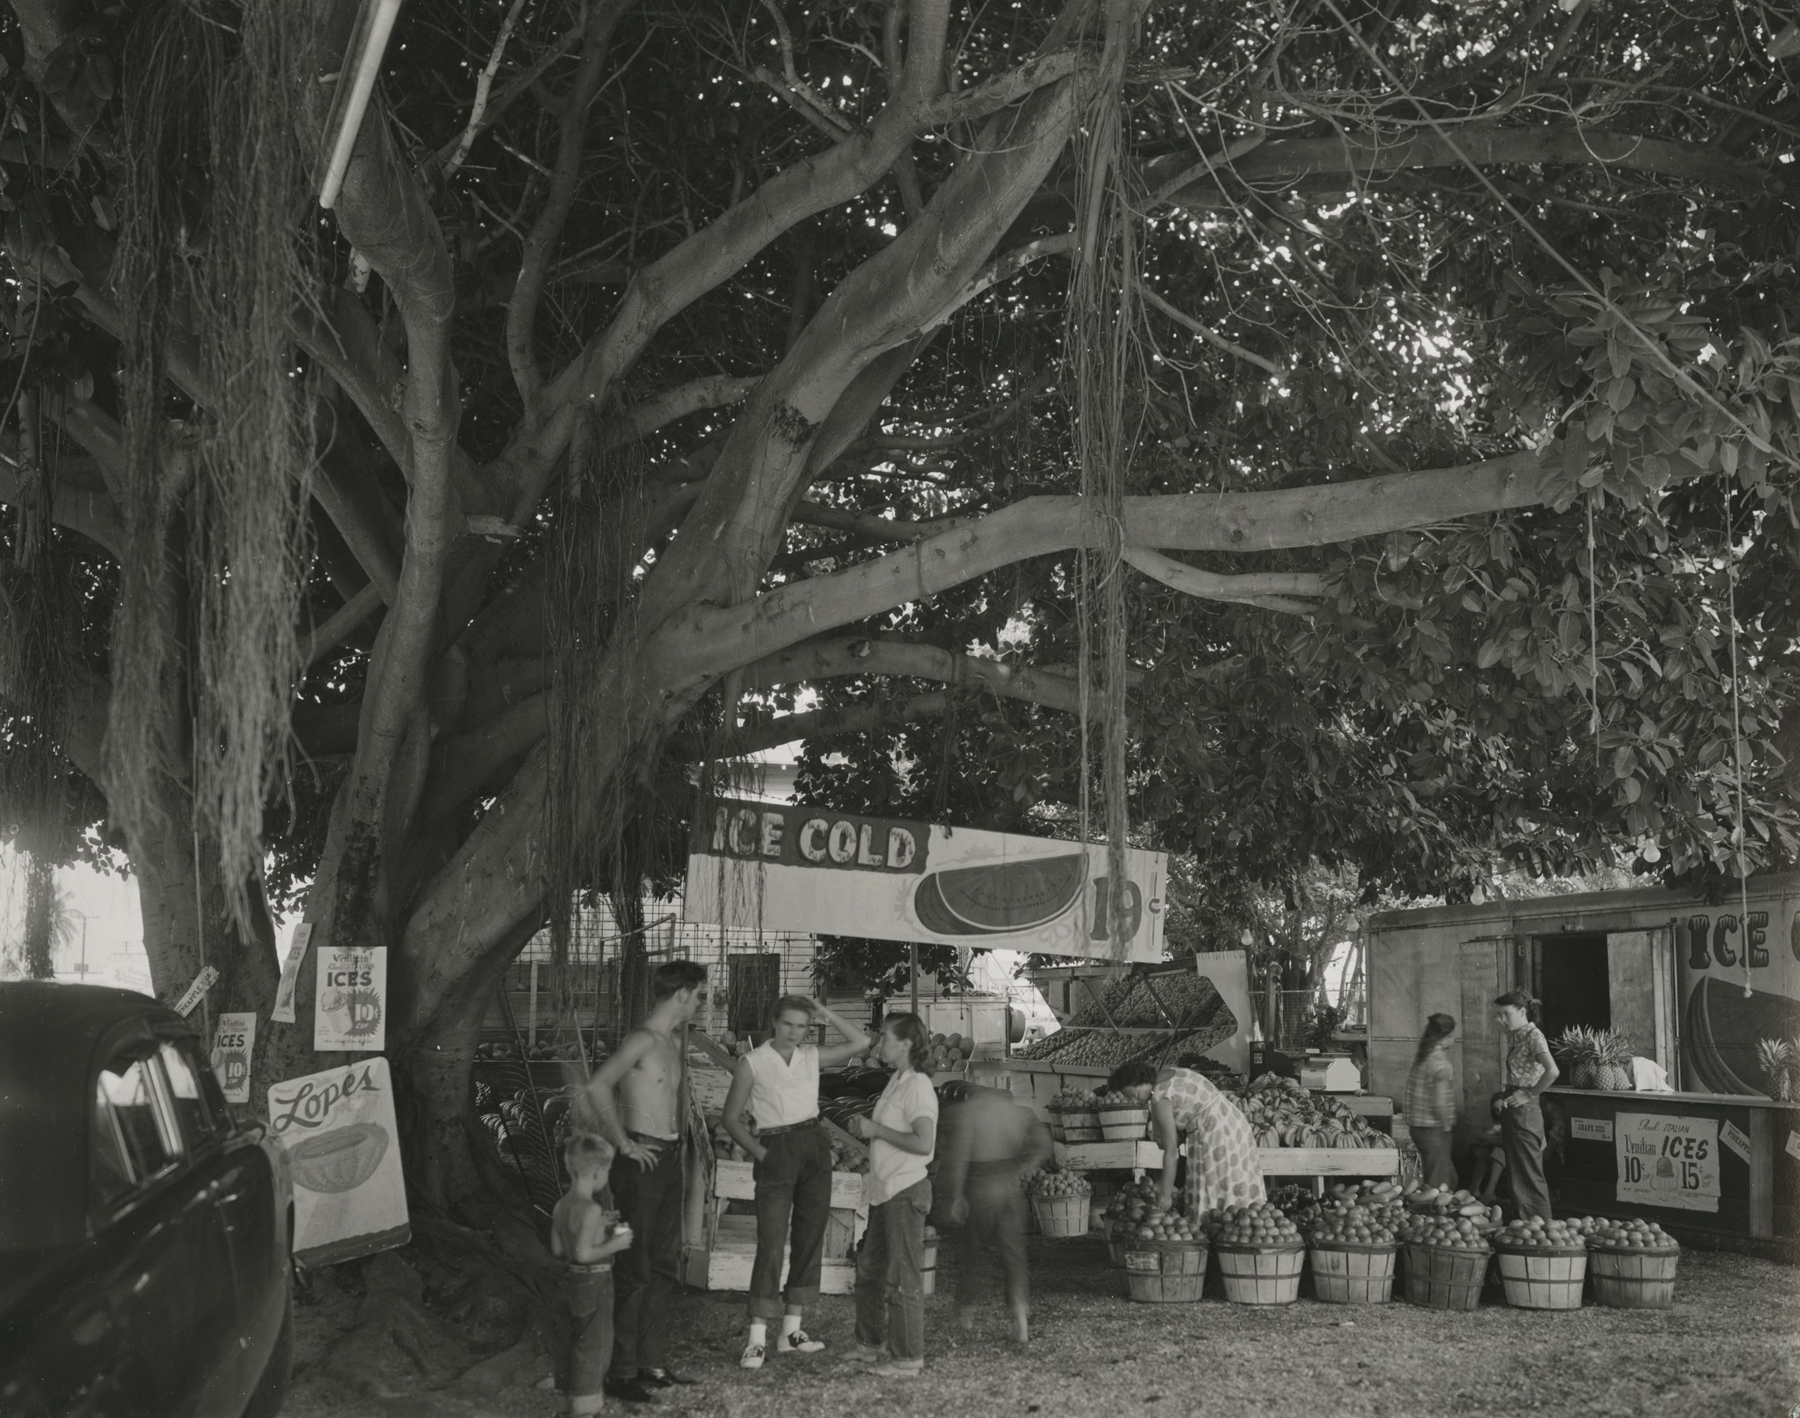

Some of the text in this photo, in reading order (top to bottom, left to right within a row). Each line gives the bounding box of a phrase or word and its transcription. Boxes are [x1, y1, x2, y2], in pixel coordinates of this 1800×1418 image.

[712, 806, 916, 870] ICE COLD
[1688, 911, 1769, 969] ICE
[327, 971, 372, 987] ICES
[216, 1033, 245, 1048] ICES
[273, 1065, 381, 1133] Lopes
[1637, 1118, 1690, 1133] Real ITALIAN
[1661, 1134, 1708, 1160] ICES
